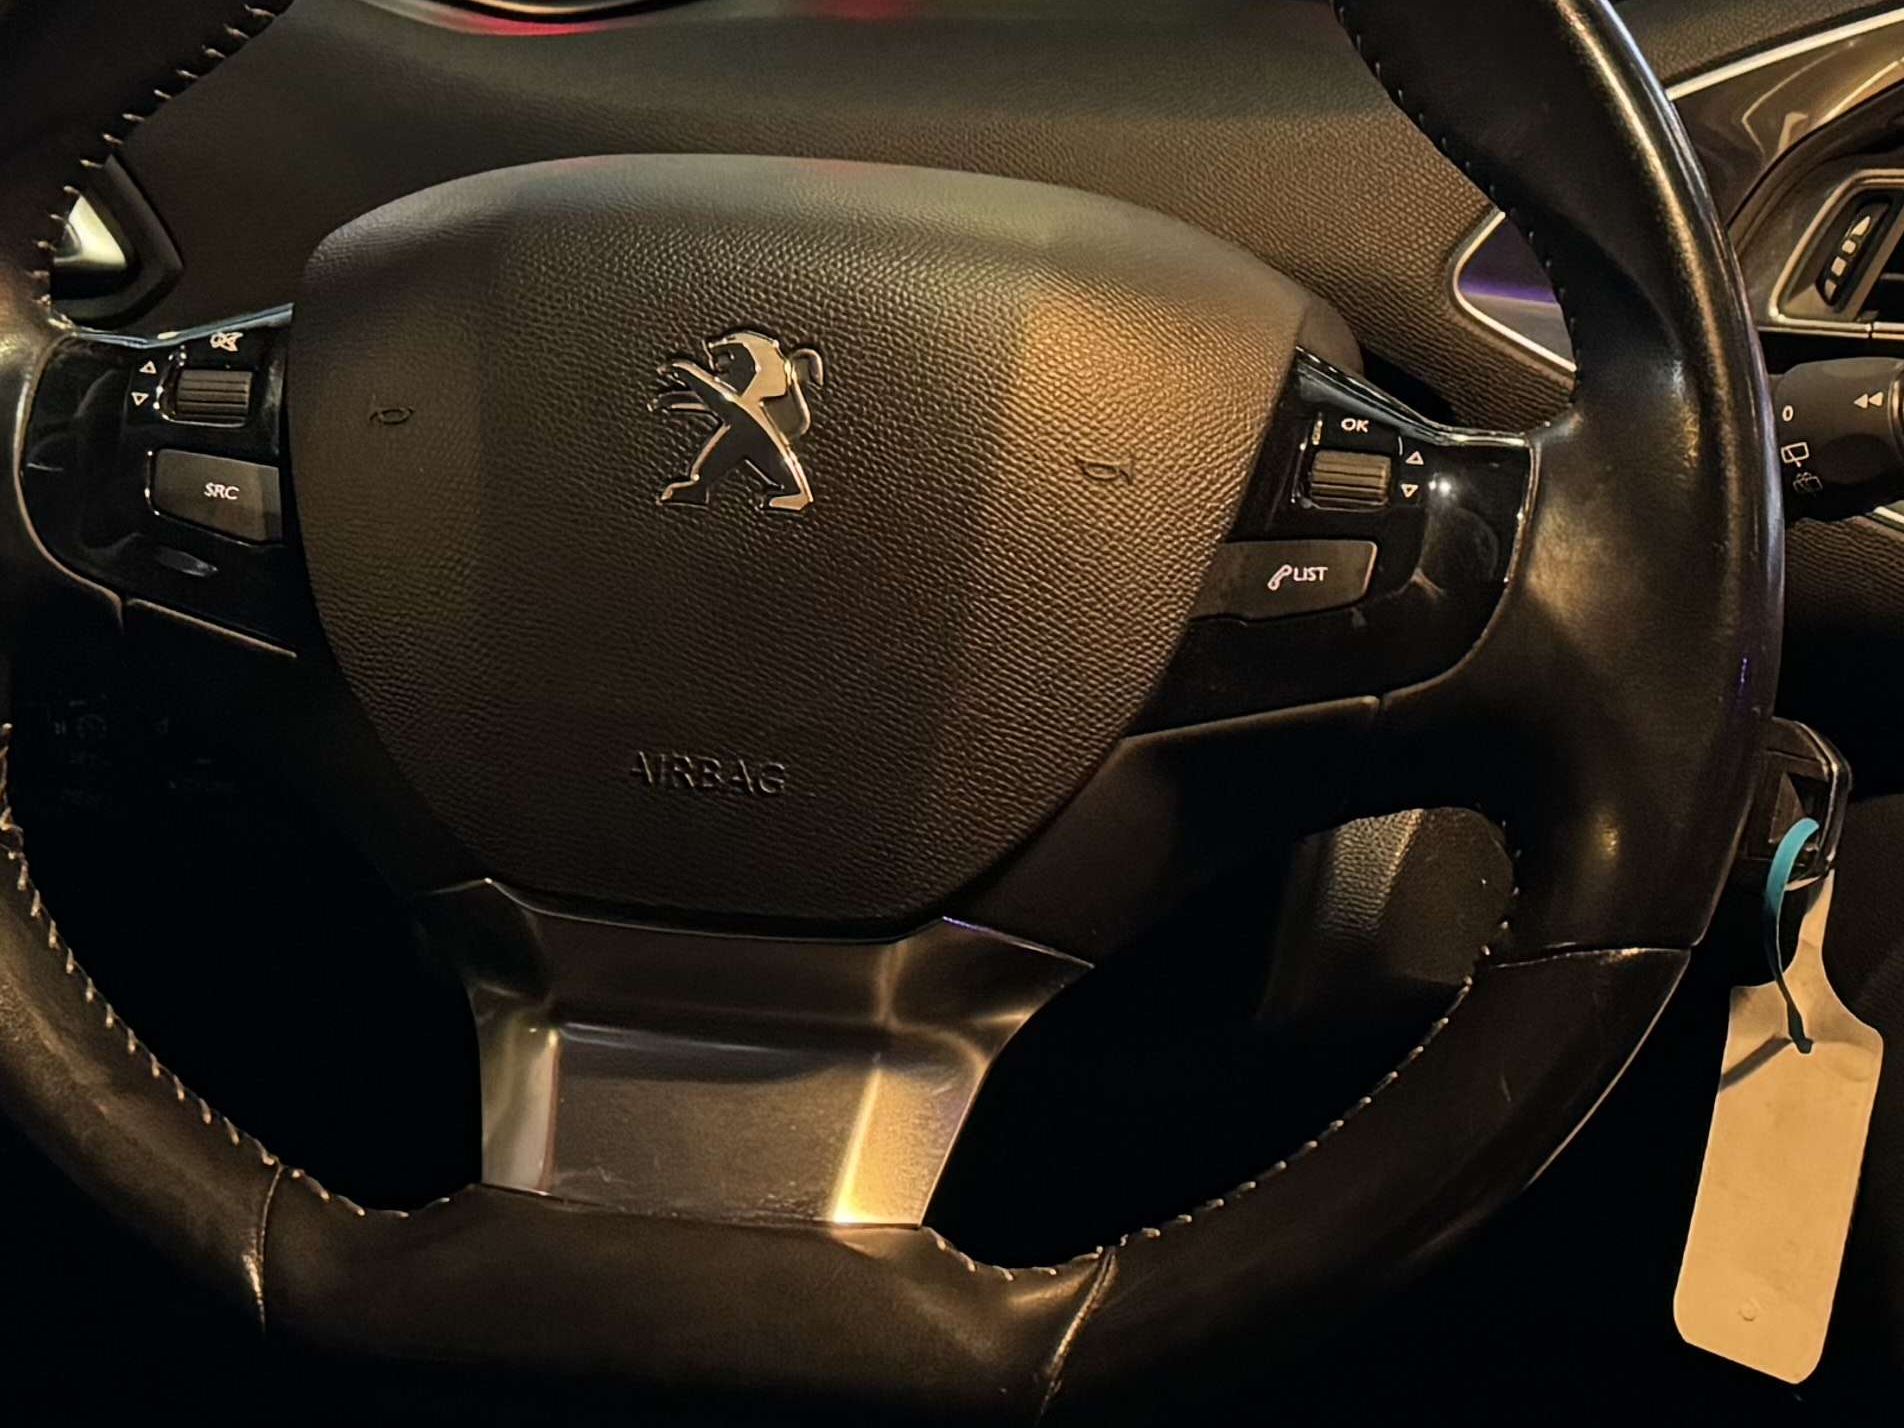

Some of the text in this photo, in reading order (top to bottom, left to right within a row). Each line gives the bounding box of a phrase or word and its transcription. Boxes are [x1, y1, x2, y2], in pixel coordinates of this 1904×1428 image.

[1340, 418, 1369, 433] OK
[204, 482, 239, 500] SRC
[1293, 566, 1328, 582] LIST
[631, 751, 785, 794] AIRBAG
